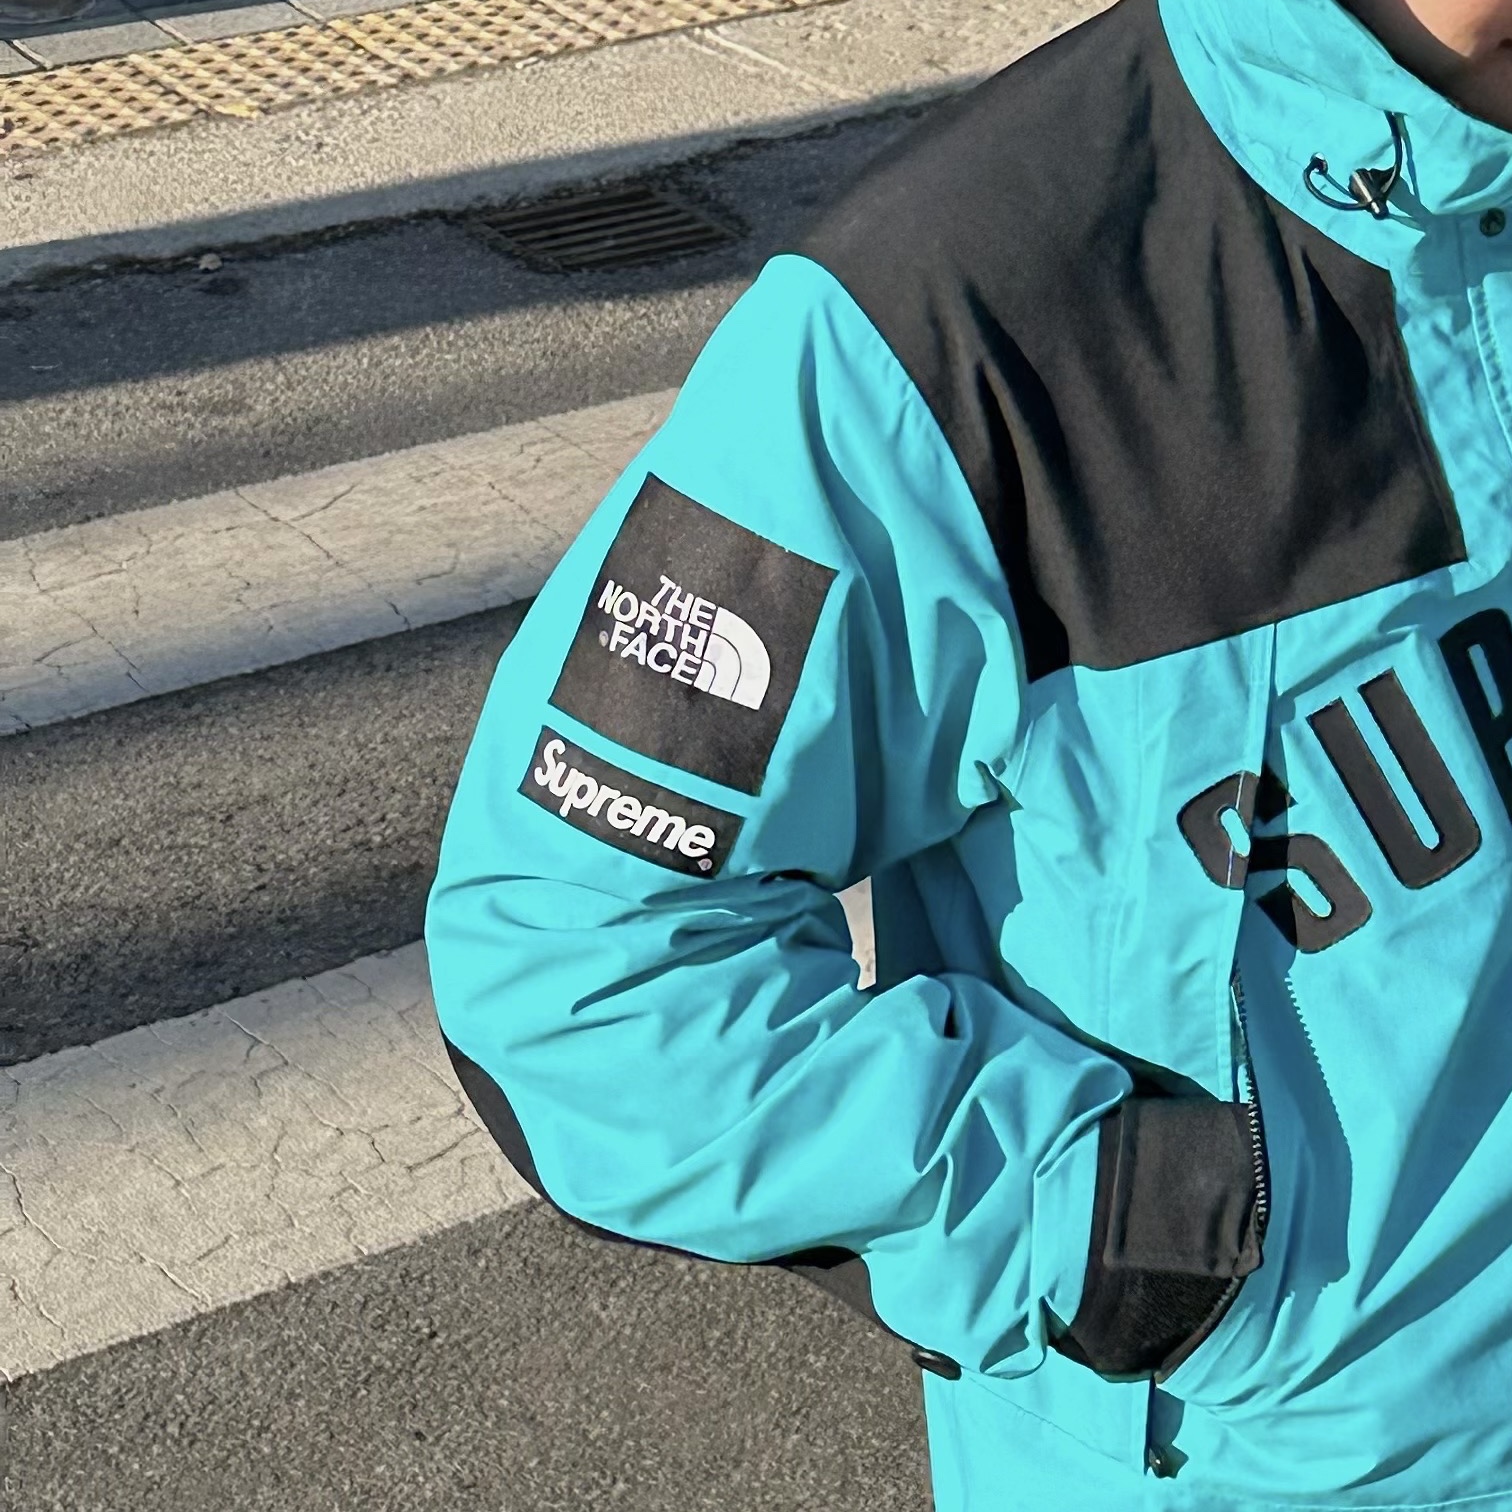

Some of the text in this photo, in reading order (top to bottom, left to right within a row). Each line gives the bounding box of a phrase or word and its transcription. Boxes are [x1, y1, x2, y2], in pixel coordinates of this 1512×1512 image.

[597, 579, 708, 659] NORTH
[651, 574, 717, 632] THE
[608, 620, 703, 686] FACE
[533, 738, 716, 858] Supreme
